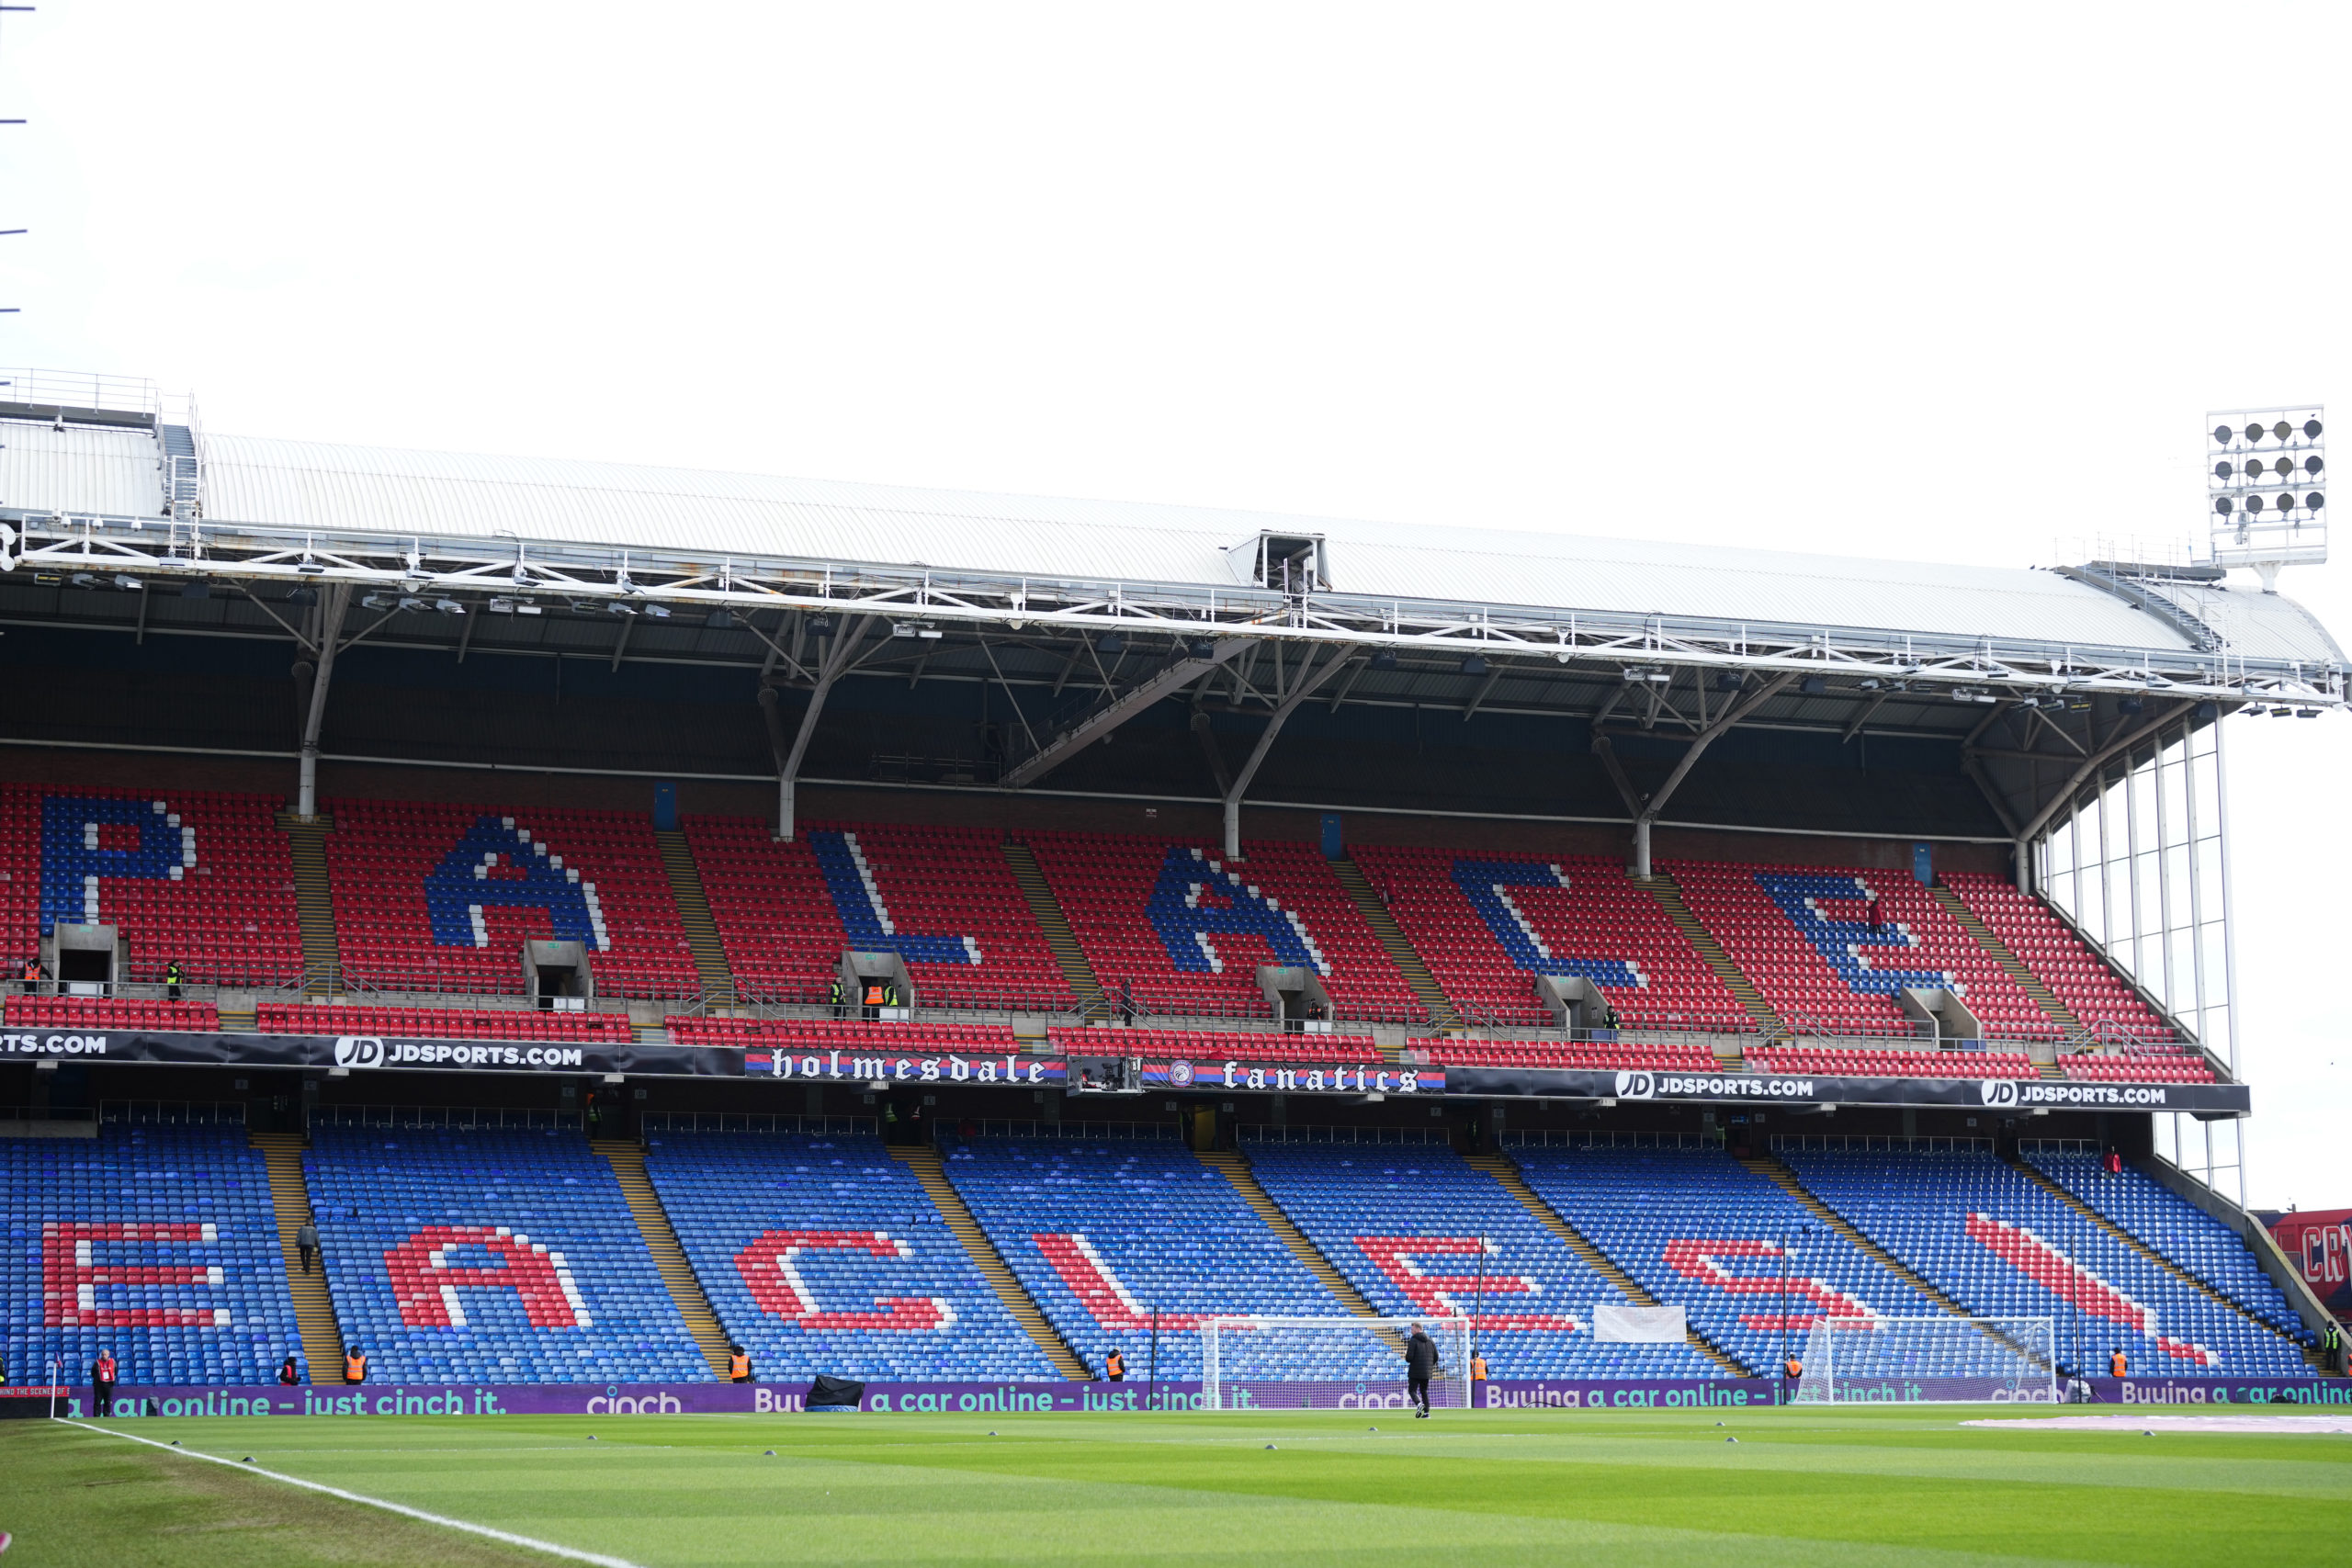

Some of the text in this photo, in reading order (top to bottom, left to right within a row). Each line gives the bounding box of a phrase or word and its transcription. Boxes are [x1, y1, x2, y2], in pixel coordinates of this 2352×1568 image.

[0, 1034, 107, 1054] TS.COM
[388, 1044, 582, 1066] JDSPORTS.COM
[771, 1048, 1046, 1084] holmesdale
[1222, 1061, 1419, 1092] fanatics
[1657, 1077, 1814, 1097] JDSPORTS.COM
[2021, 1087, 2166, 1104] JDSPORTS.COM
[162, 1390, 270, 1416] online
[305, 1389, 368, 1416] just
[376, 1388, 463, 1416] cinch
[474, 1388, 506, 1416] it.
[586, 1385, 682, 1414] cinch
[870, 1393, 891, 1412] a
[899, 1393, 953, 1412] car
[959, 1385, 1053, 1412] online
[1082, 1385, 1137, 1411] just
[1486, 1383, 1579, 1408] Buying
[1588, 1389, 1606, 1407] a
[1613, 1388, 1659, 1407] car
[1666, 1382, 1747, 1407] online
[2121, 1381, 2205, 1404] Buying
[2212, 1386, 2233, 1404] a
